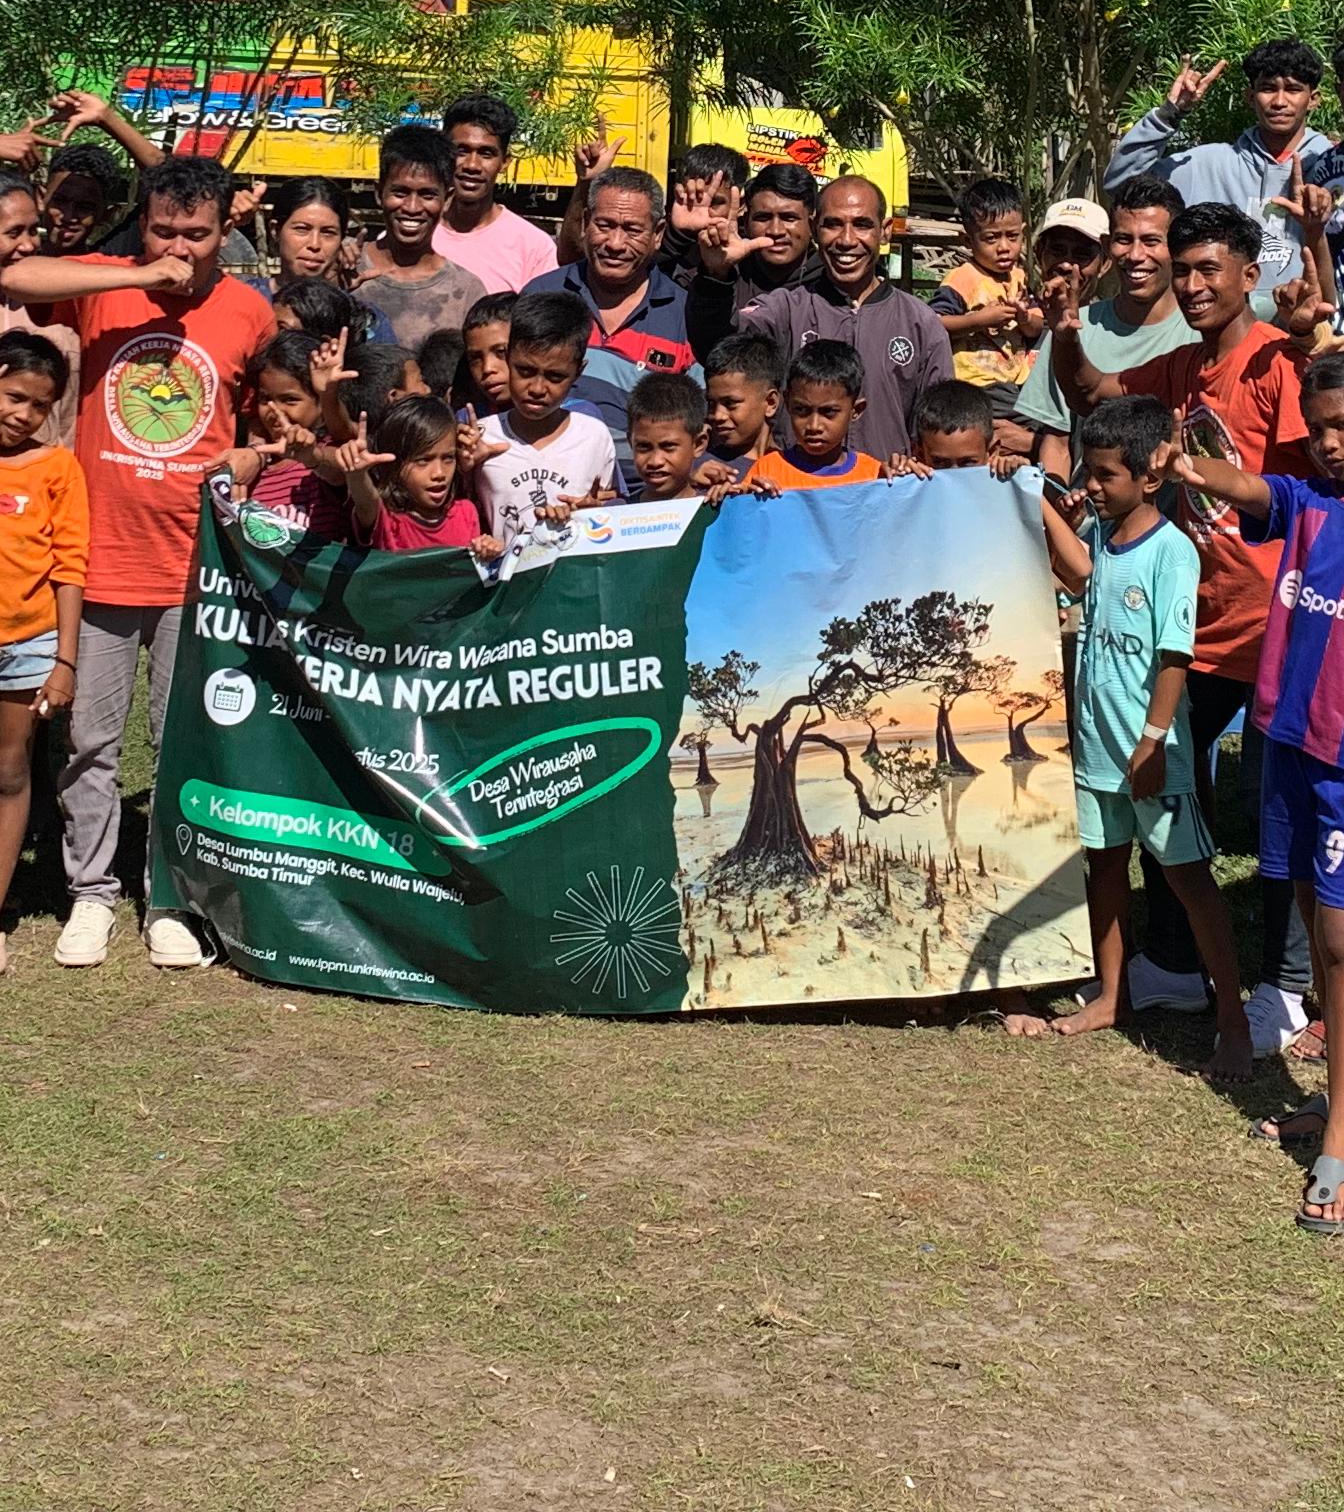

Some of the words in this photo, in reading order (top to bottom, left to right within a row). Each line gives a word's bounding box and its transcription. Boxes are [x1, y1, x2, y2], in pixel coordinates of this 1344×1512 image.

[746, 123, 800, 140] LIPSTIK
[135, 468, 165, 481] 2025
[510, 468, 571, 490] SUDDEN
[294, 616, 386, 664] Kristen
[394, 642, 453, 670] Wira
[459, 637, 537, 670] Wacana
[542, 624, 634, 656] Sumba
[392, 674, 501, 714] NYATA
[508, 655, 664, 706] REGULER
[289, 696, 324, 721] Juni
[387, 748, 441, 776] 2025
[467, 773, 511, 803] Desa
[509, 741, 598, 786] Wirausaha
[489, 766, 585, 820] Terintegrasi
[209, 794, 323, 838] Kelompok
[327, 816, 379, 852] KKN
[387, 831, 415, 857] 18
[196, 848, 221, 868] Kab.
[221, 857, 269, 880] Sumba
[271, 866, 315, 887] Timur
[197, 833, 225, 853] Desa
[226, 839, 273, 864] Lumbu
[274, 850, 340, 877] Manggit,
[340, 862, 369, 882] Kec.
[371, 870, 411, 892] Wulla
